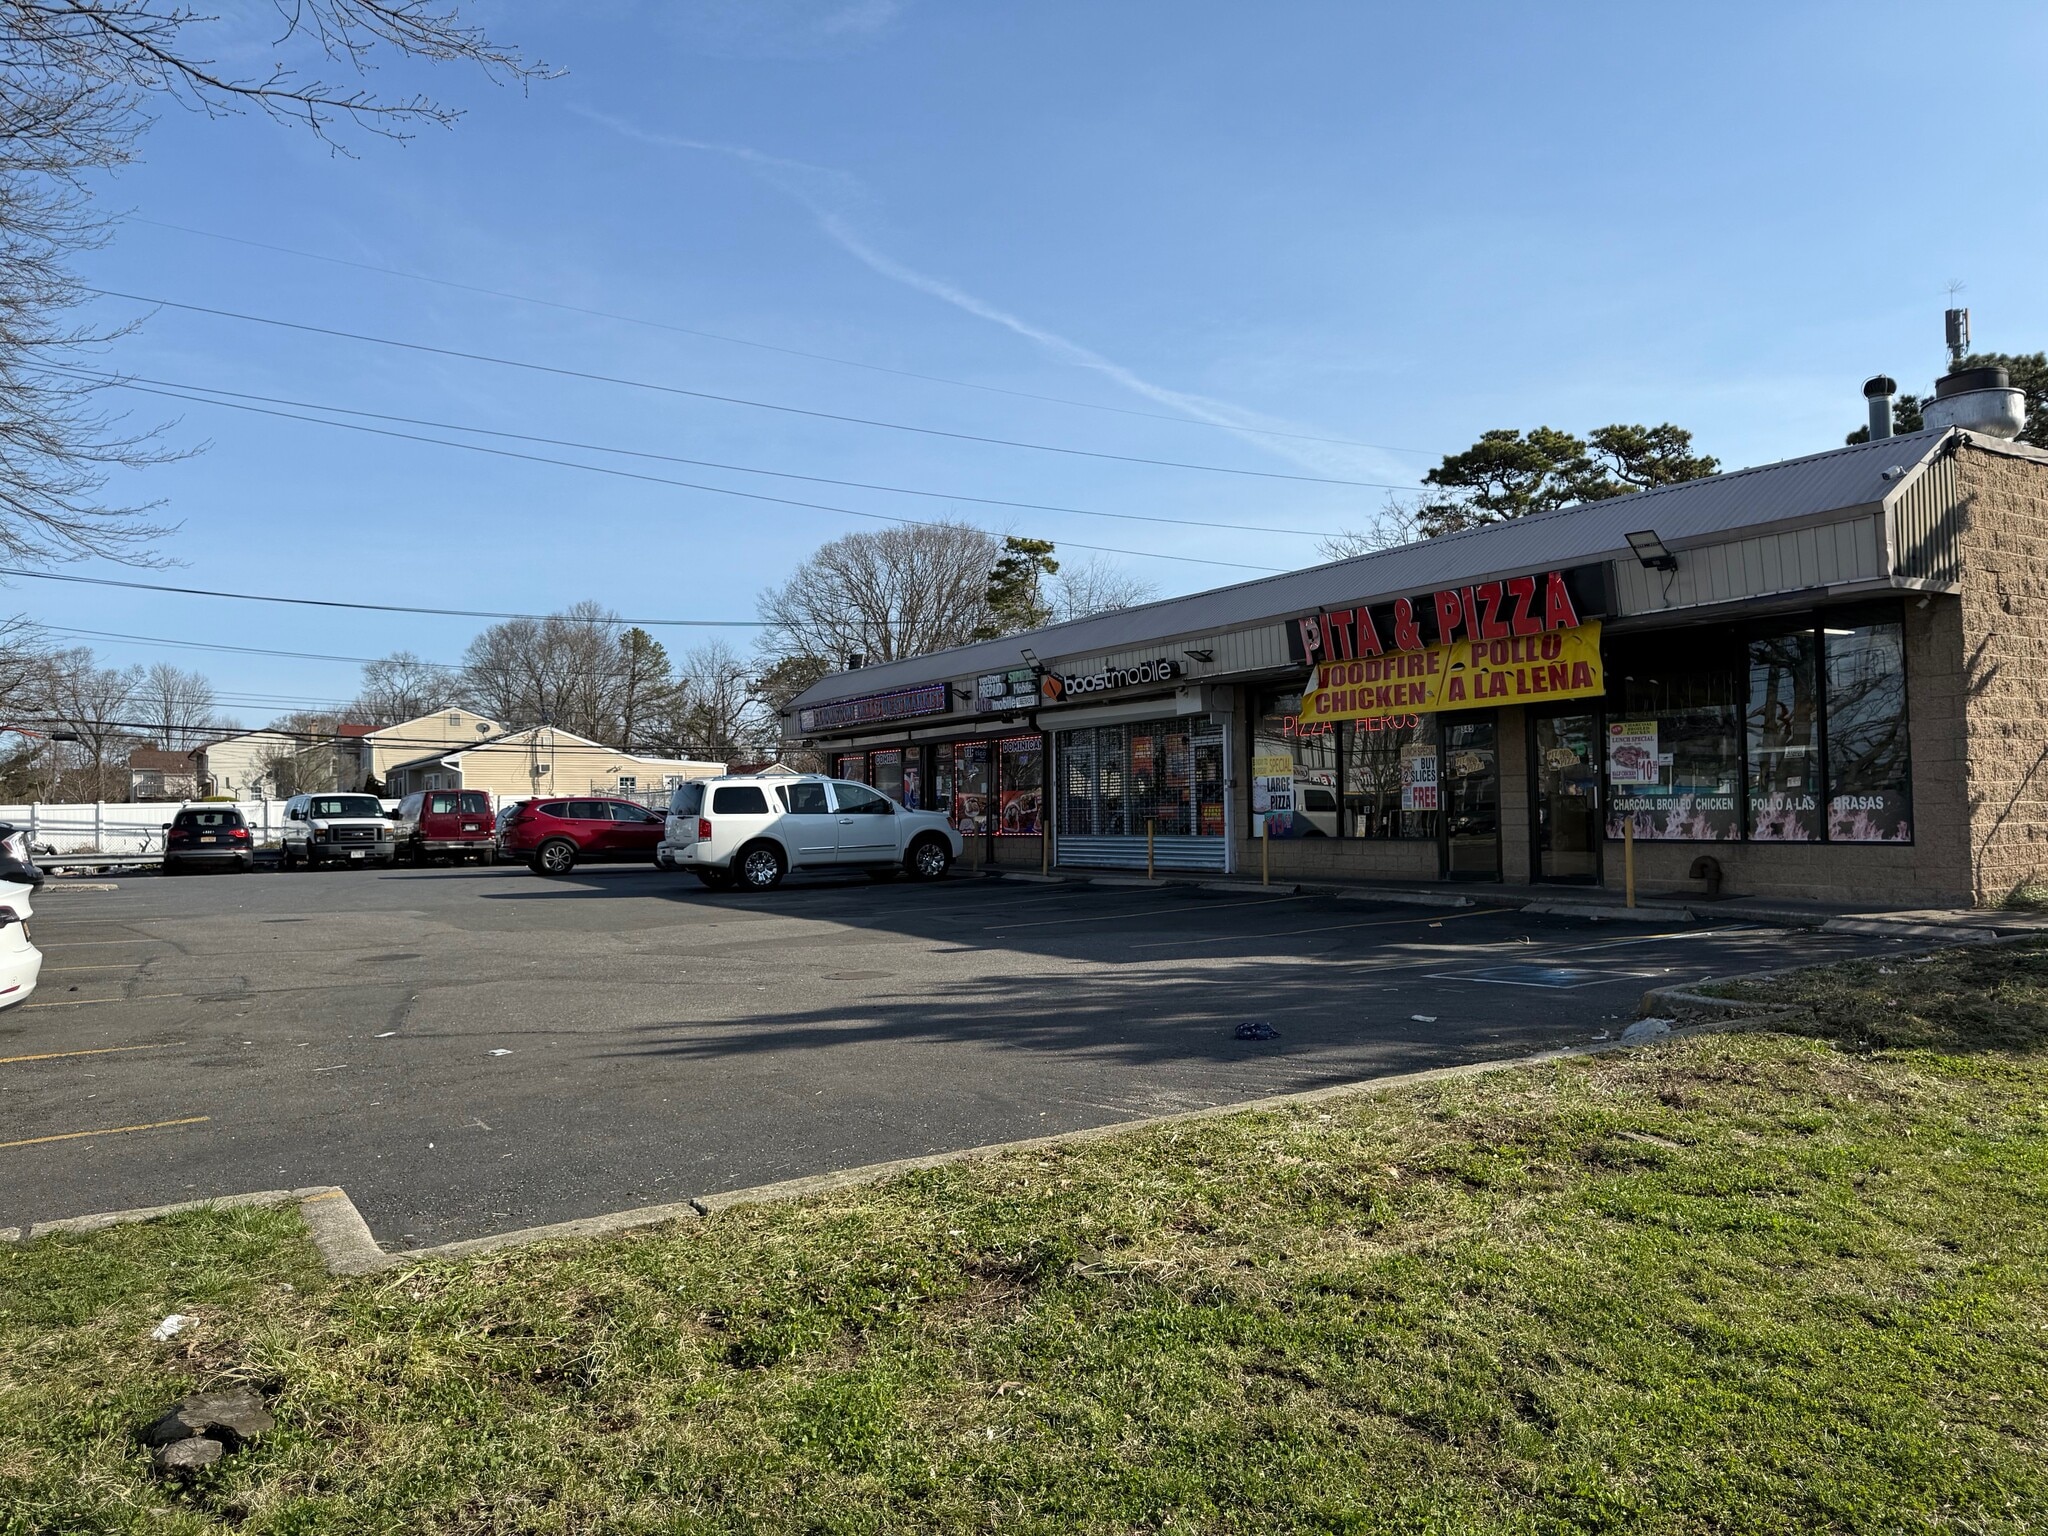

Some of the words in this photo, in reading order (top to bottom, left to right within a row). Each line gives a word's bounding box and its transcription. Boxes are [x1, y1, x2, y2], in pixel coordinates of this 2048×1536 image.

[1299, 606, 1383, 665] PITA
[1394, 597, 1424, 651] &
[1434, 571, 1580, 646] PIZZA
[1471, 633, 1562, 669] POLLO
[978, 674, 1000, 685] verizon
[1450, 677, 1466, 702] A
[1474, 670, 1509, 699] LA
[1516, 659, 1594, 694] LEÑA
[979, 683, 1003, 698] PREPAID
[1013, 681, 1032, 695] Mobile
[1315, 681, 1427, 715] CHICKEN
[1283, 715, 1334, 738] PIZZA
[1355, 713, 1420, 732] HEROS
[875, 753, 898, 765] COMIDA
[1269, 757, 1292, 773] SPECIAL
[1421, 757, 1436, 769] BUY
[1404, 771, 1409, 782] 2
[1411, 770, 1436, 782] SLICES
[1267, 777, 1291, 792] LARGE
[1270, 795, 1291, 810] PIZZA
[1413, 786, 1436, 807] FREE
[1613, 798, 1655, 811] CHARCOAL
[1656, 797, 1692, 810] BROILED
[1695, 797, 1734, 810] CHICKEN
[1750, 798, 1783, 811] POLLO
[1785, 798, 1793, 811] A
[1795, 797, 1815, 811] LAS
[1833, 795, 1884, 810] BRASAS
